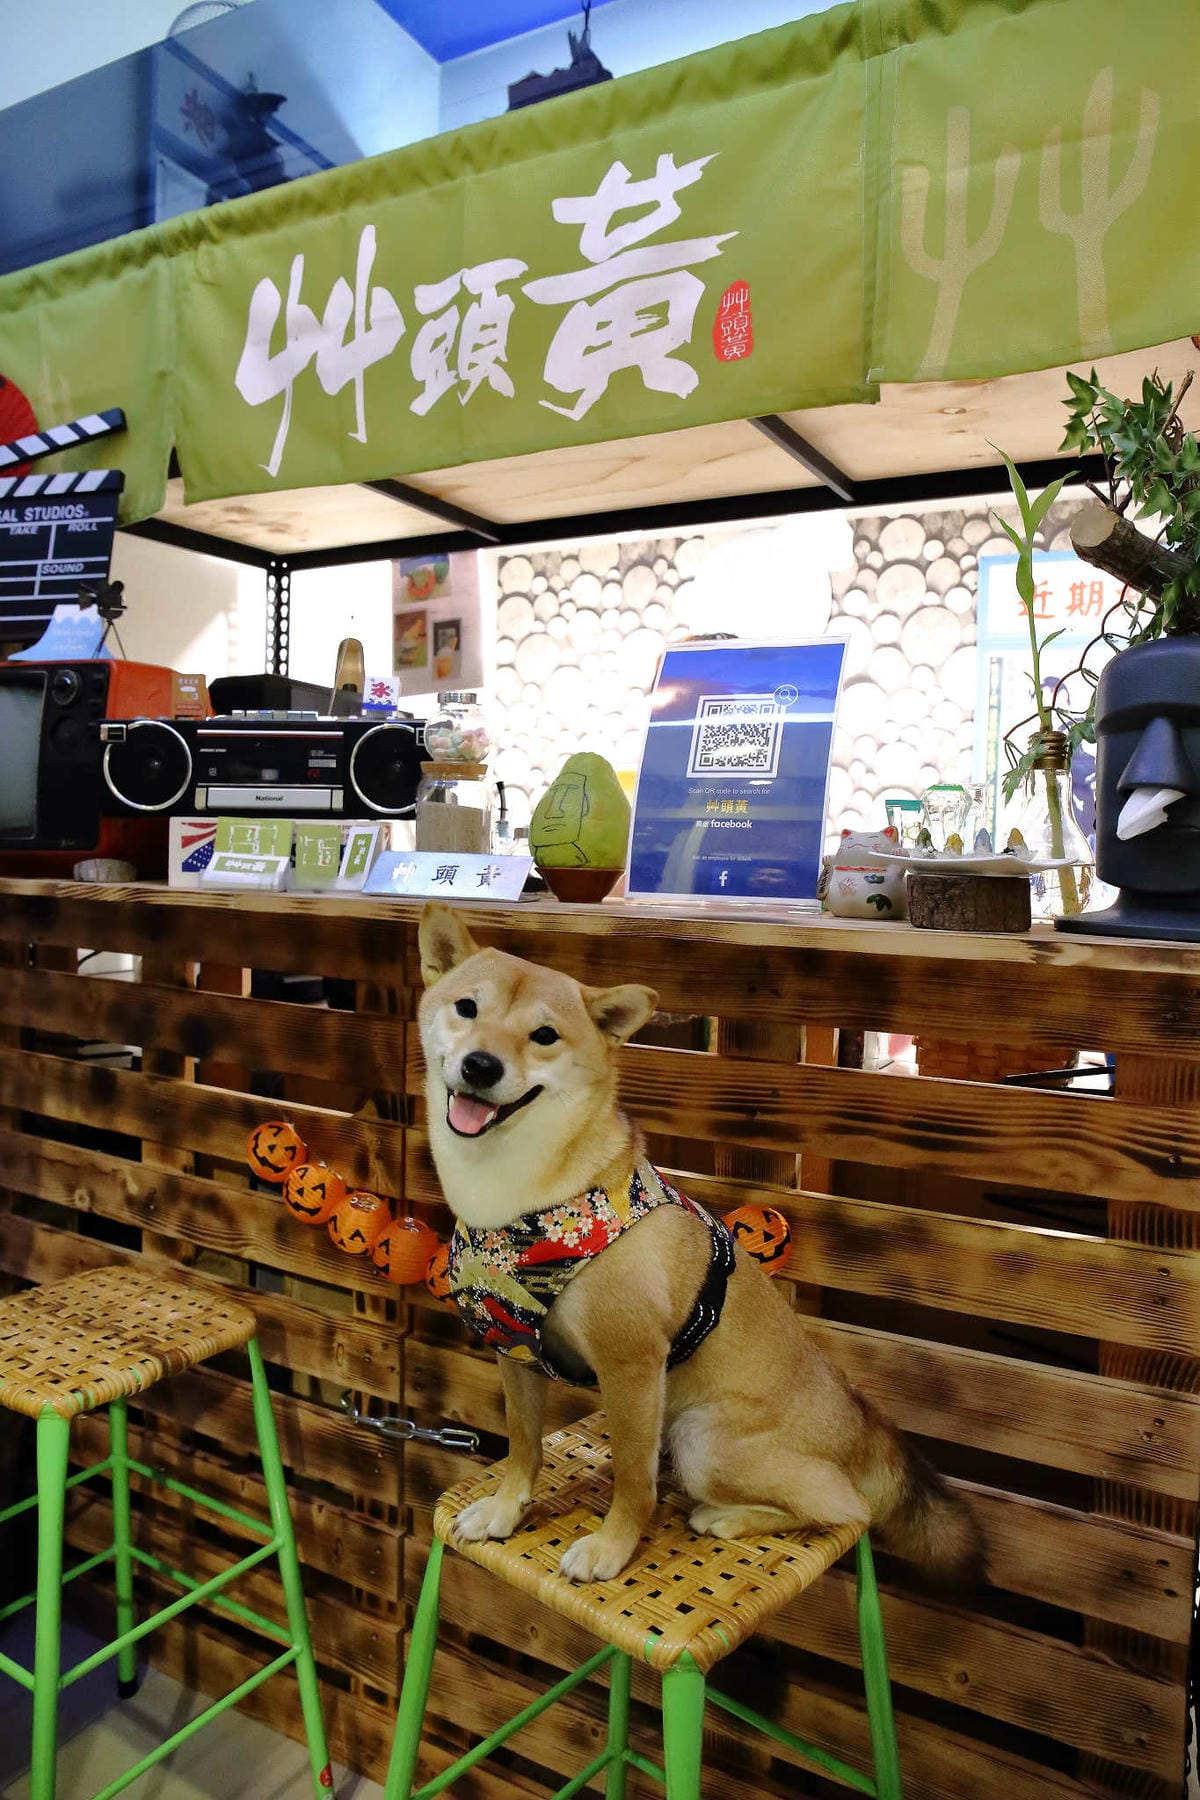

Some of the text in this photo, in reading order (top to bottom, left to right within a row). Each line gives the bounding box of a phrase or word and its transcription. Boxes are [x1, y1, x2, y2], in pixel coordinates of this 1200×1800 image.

[0, 503, 85, 523] AL STUDIOS
[9, 521, 98, 535] TAKE ROLL
[42, 562, 85, 575] SOUND
[688, 787, 704, 795] Scan
[716, 787, 731, 795] code
[740, 788, 762, 796] search
[711, 819, 753, 829] facebook
